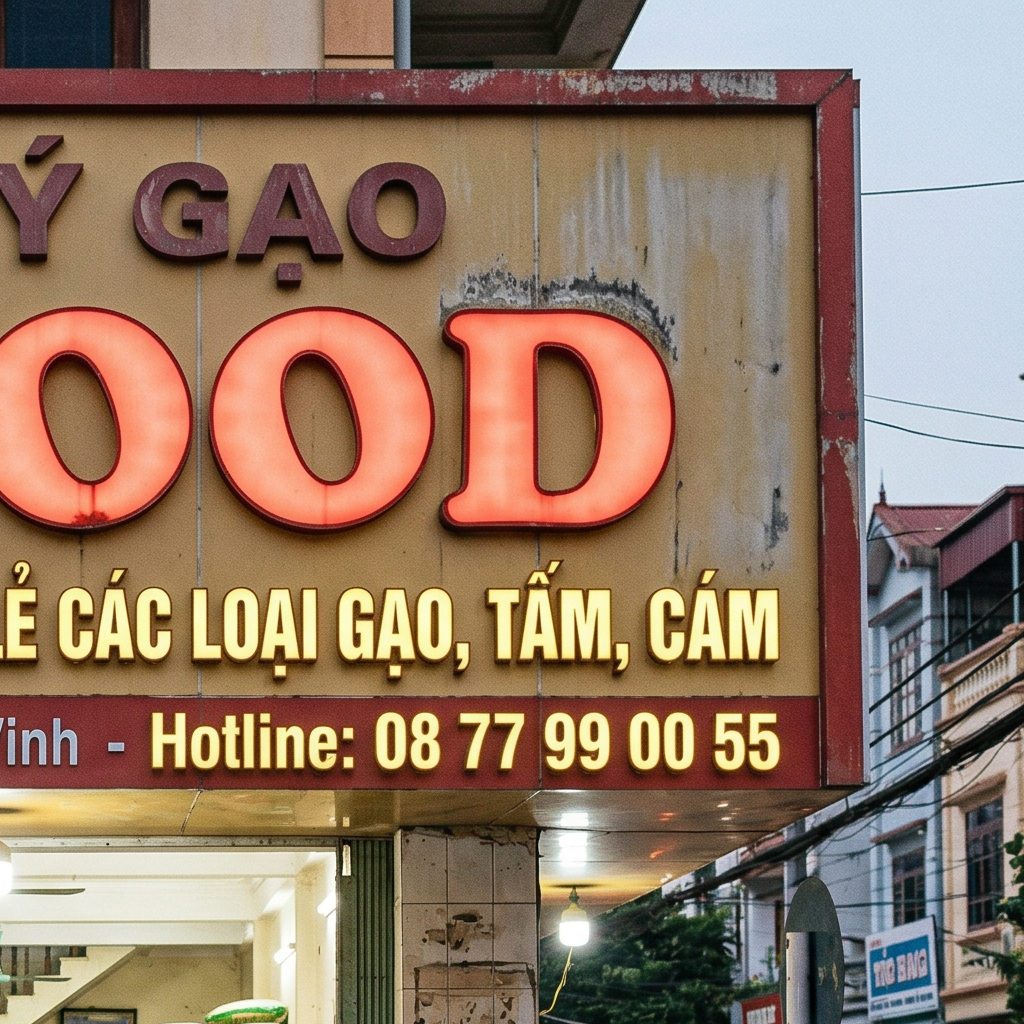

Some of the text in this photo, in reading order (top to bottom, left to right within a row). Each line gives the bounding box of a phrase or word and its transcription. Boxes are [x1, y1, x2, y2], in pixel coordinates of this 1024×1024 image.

[133, 161, 447, 288] GẠO
[57, 568, 172, 664] CÁC
[191, 588, 319, 681] LOẠI
[337, 588, 470, 681] GẠO,
[485, 560, 630, 674] TẤM,
[648, 570, 780, 664] CÁM
[150, 712, 355, 770] Hotline:
[375, 712, 441, 772] 08
[458, 712, 525, 771] 77
[544, 712, 609, 772] 99
[628, 712, 695, 772] 00
[713, 712, 780, 772] 55
